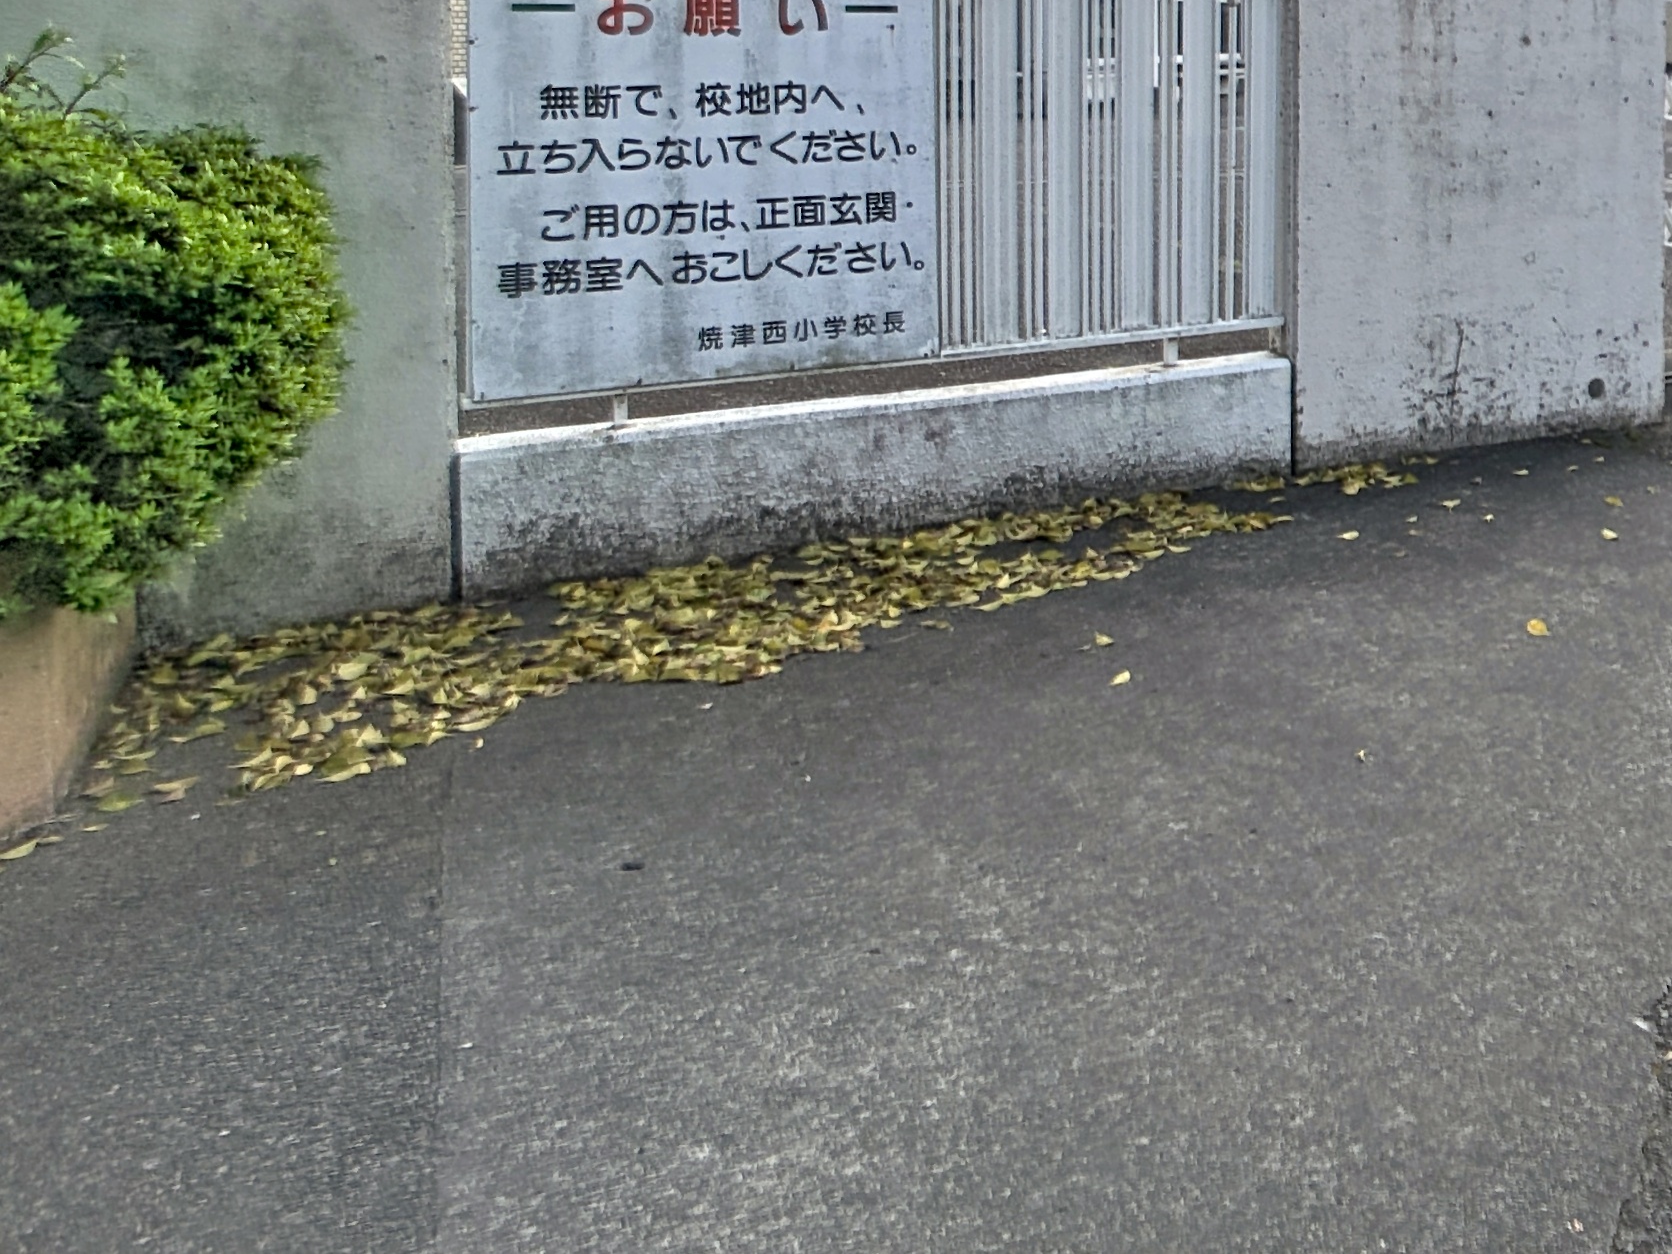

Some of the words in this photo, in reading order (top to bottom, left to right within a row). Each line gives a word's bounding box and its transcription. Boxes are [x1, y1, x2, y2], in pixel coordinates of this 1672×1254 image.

[497, 130, 918, 176] 立ち入らないでください。
[497, 241, 926, 298] 事務室へおこしください。
[698, 310, 906, 351] 焼津西小学校長
